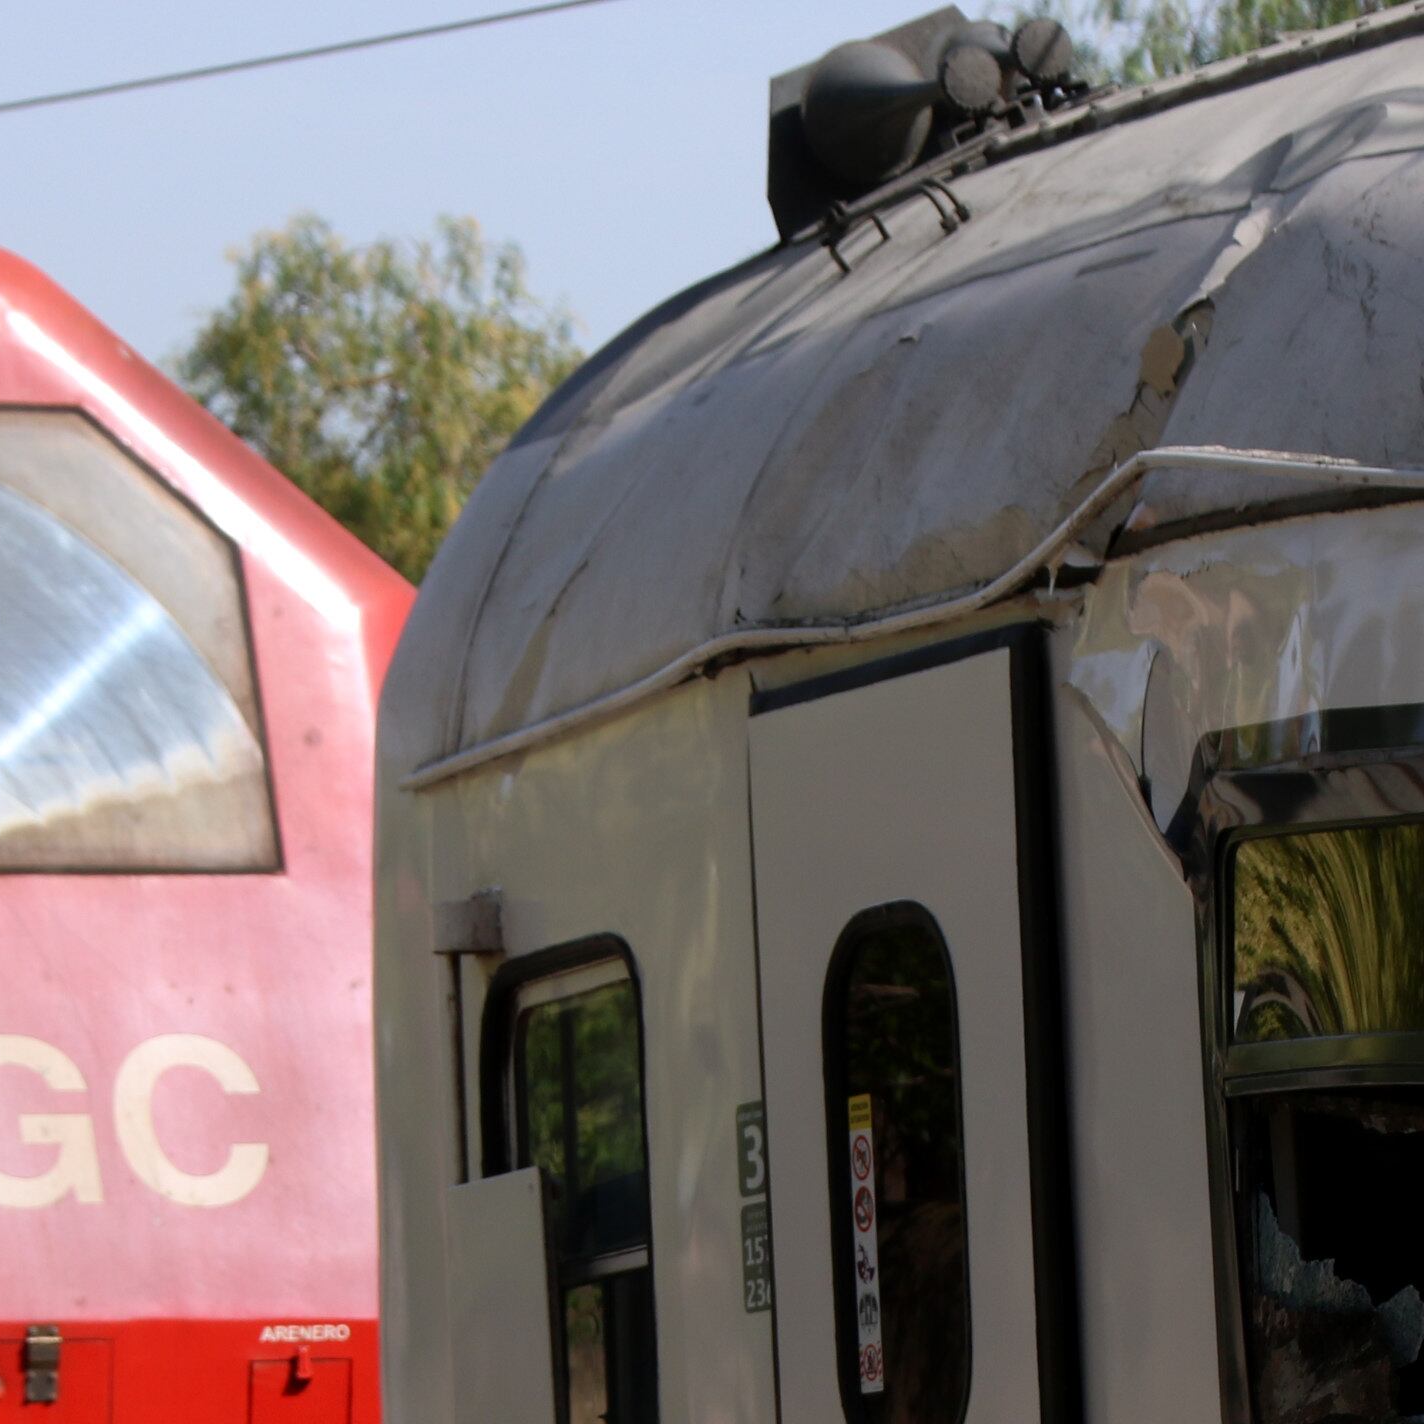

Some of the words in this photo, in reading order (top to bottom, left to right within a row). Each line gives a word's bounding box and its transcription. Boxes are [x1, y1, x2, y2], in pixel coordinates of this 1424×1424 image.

[743, 1124, 765, 1185] 3
[744, 1233, 770, 1266] 15
[259, 1323, 351, 1343] ARENERO
